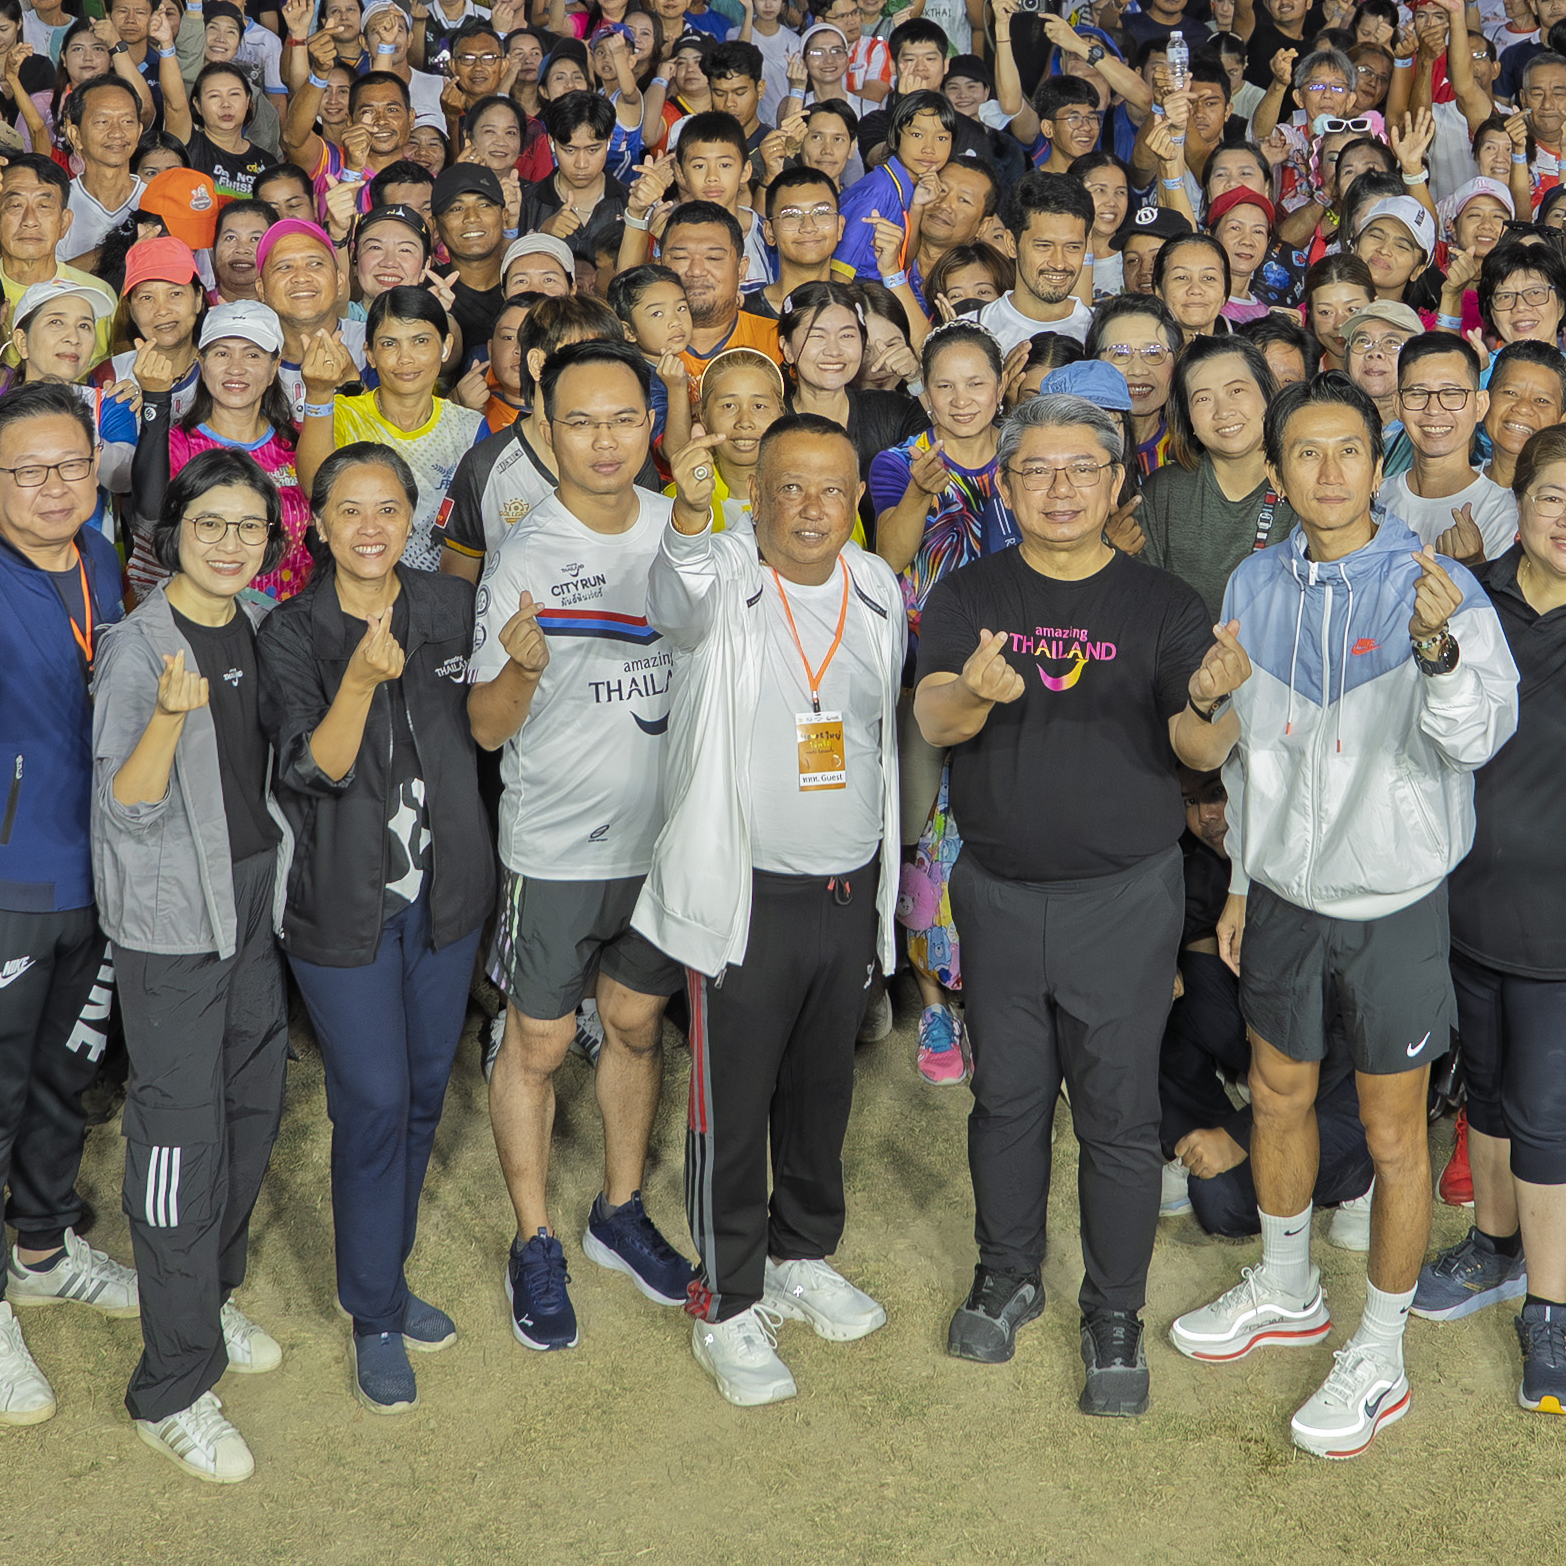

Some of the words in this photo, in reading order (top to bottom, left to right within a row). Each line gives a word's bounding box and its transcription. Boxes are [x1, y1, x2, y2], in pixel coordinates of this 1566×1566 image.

[550, 579, 583, 598] CITY
[582, 573, 607, 590] RUN
[1035, 625, 1088, 642] amazing
[1009, 631, 1118, 662] THAILAND
[821, 773, 843, 782] Guest
[4, 955, 31, 977] NIKE
